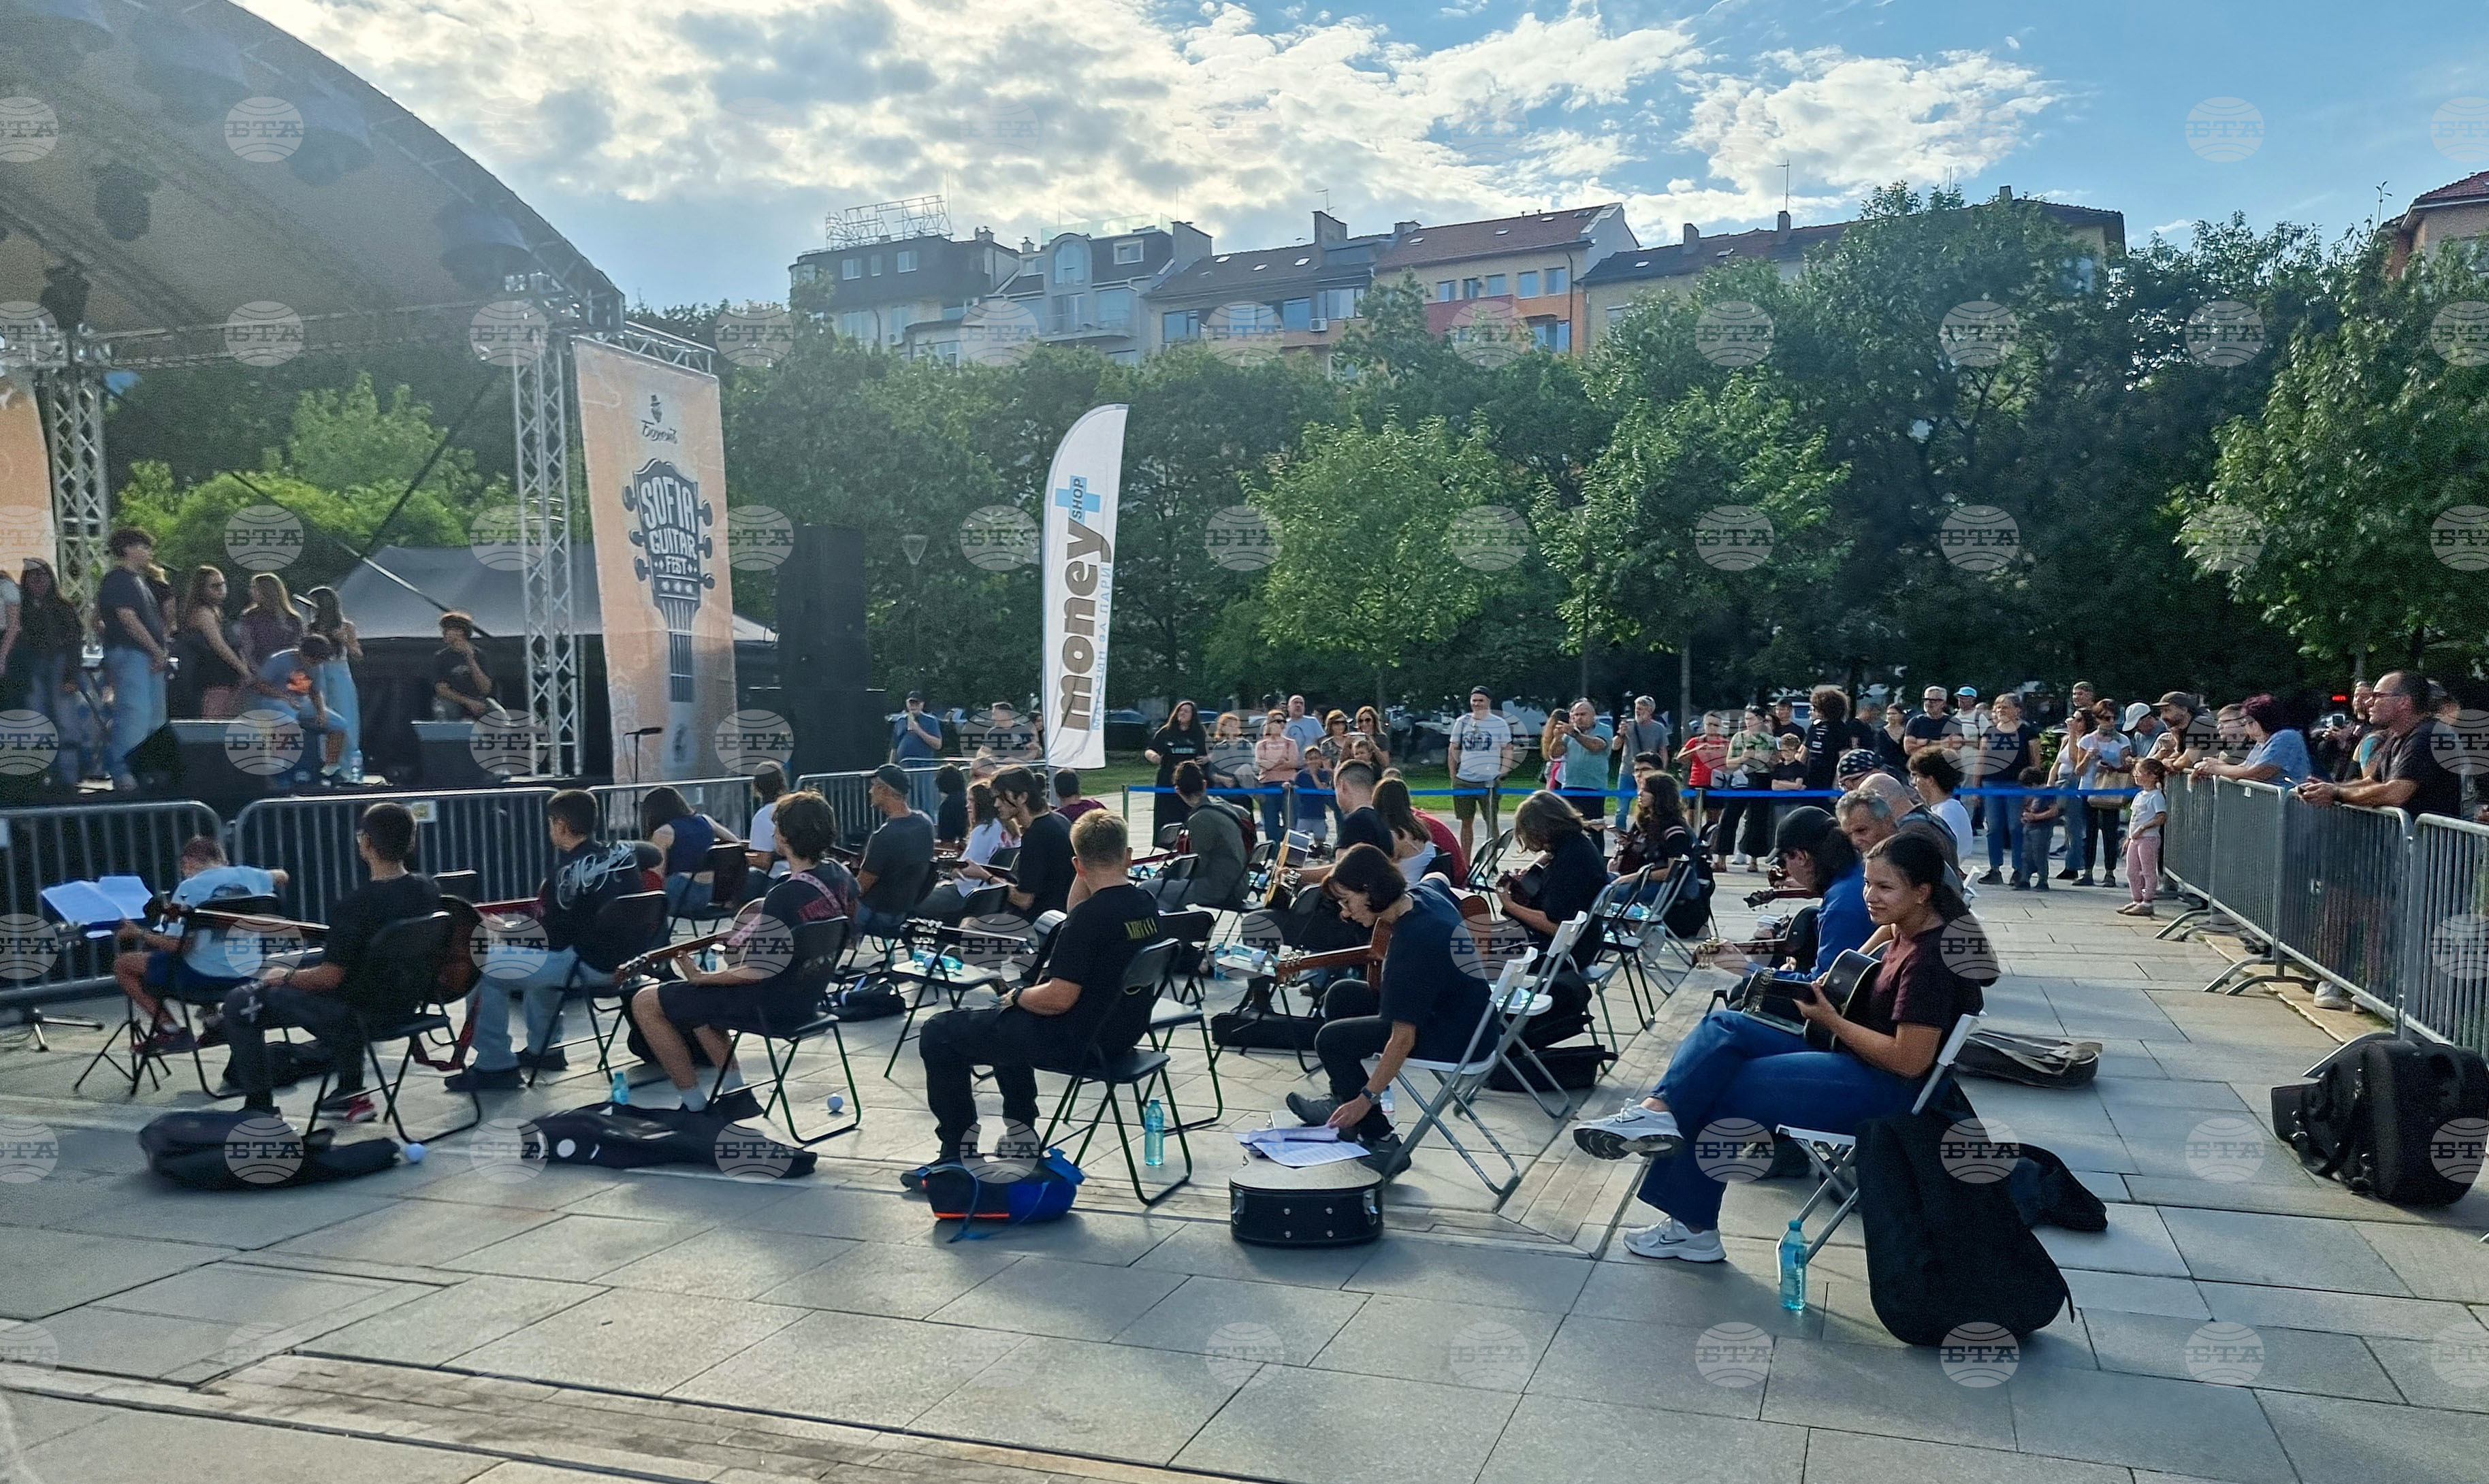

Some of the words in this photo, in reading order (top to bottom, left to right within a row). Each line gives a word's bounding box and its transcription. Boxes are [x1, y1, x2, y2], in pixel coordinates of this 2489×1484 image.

[641, 477, 696, 533] SOFIA
[1072, 478, 1085, 519] SHOP
[649, 528, 697, 560] GUITAR
[664, 555, 688, 575] FEST
[1099, 566, 1112, 614] ПАРИ
[1060, 517, 1112, 732] money
